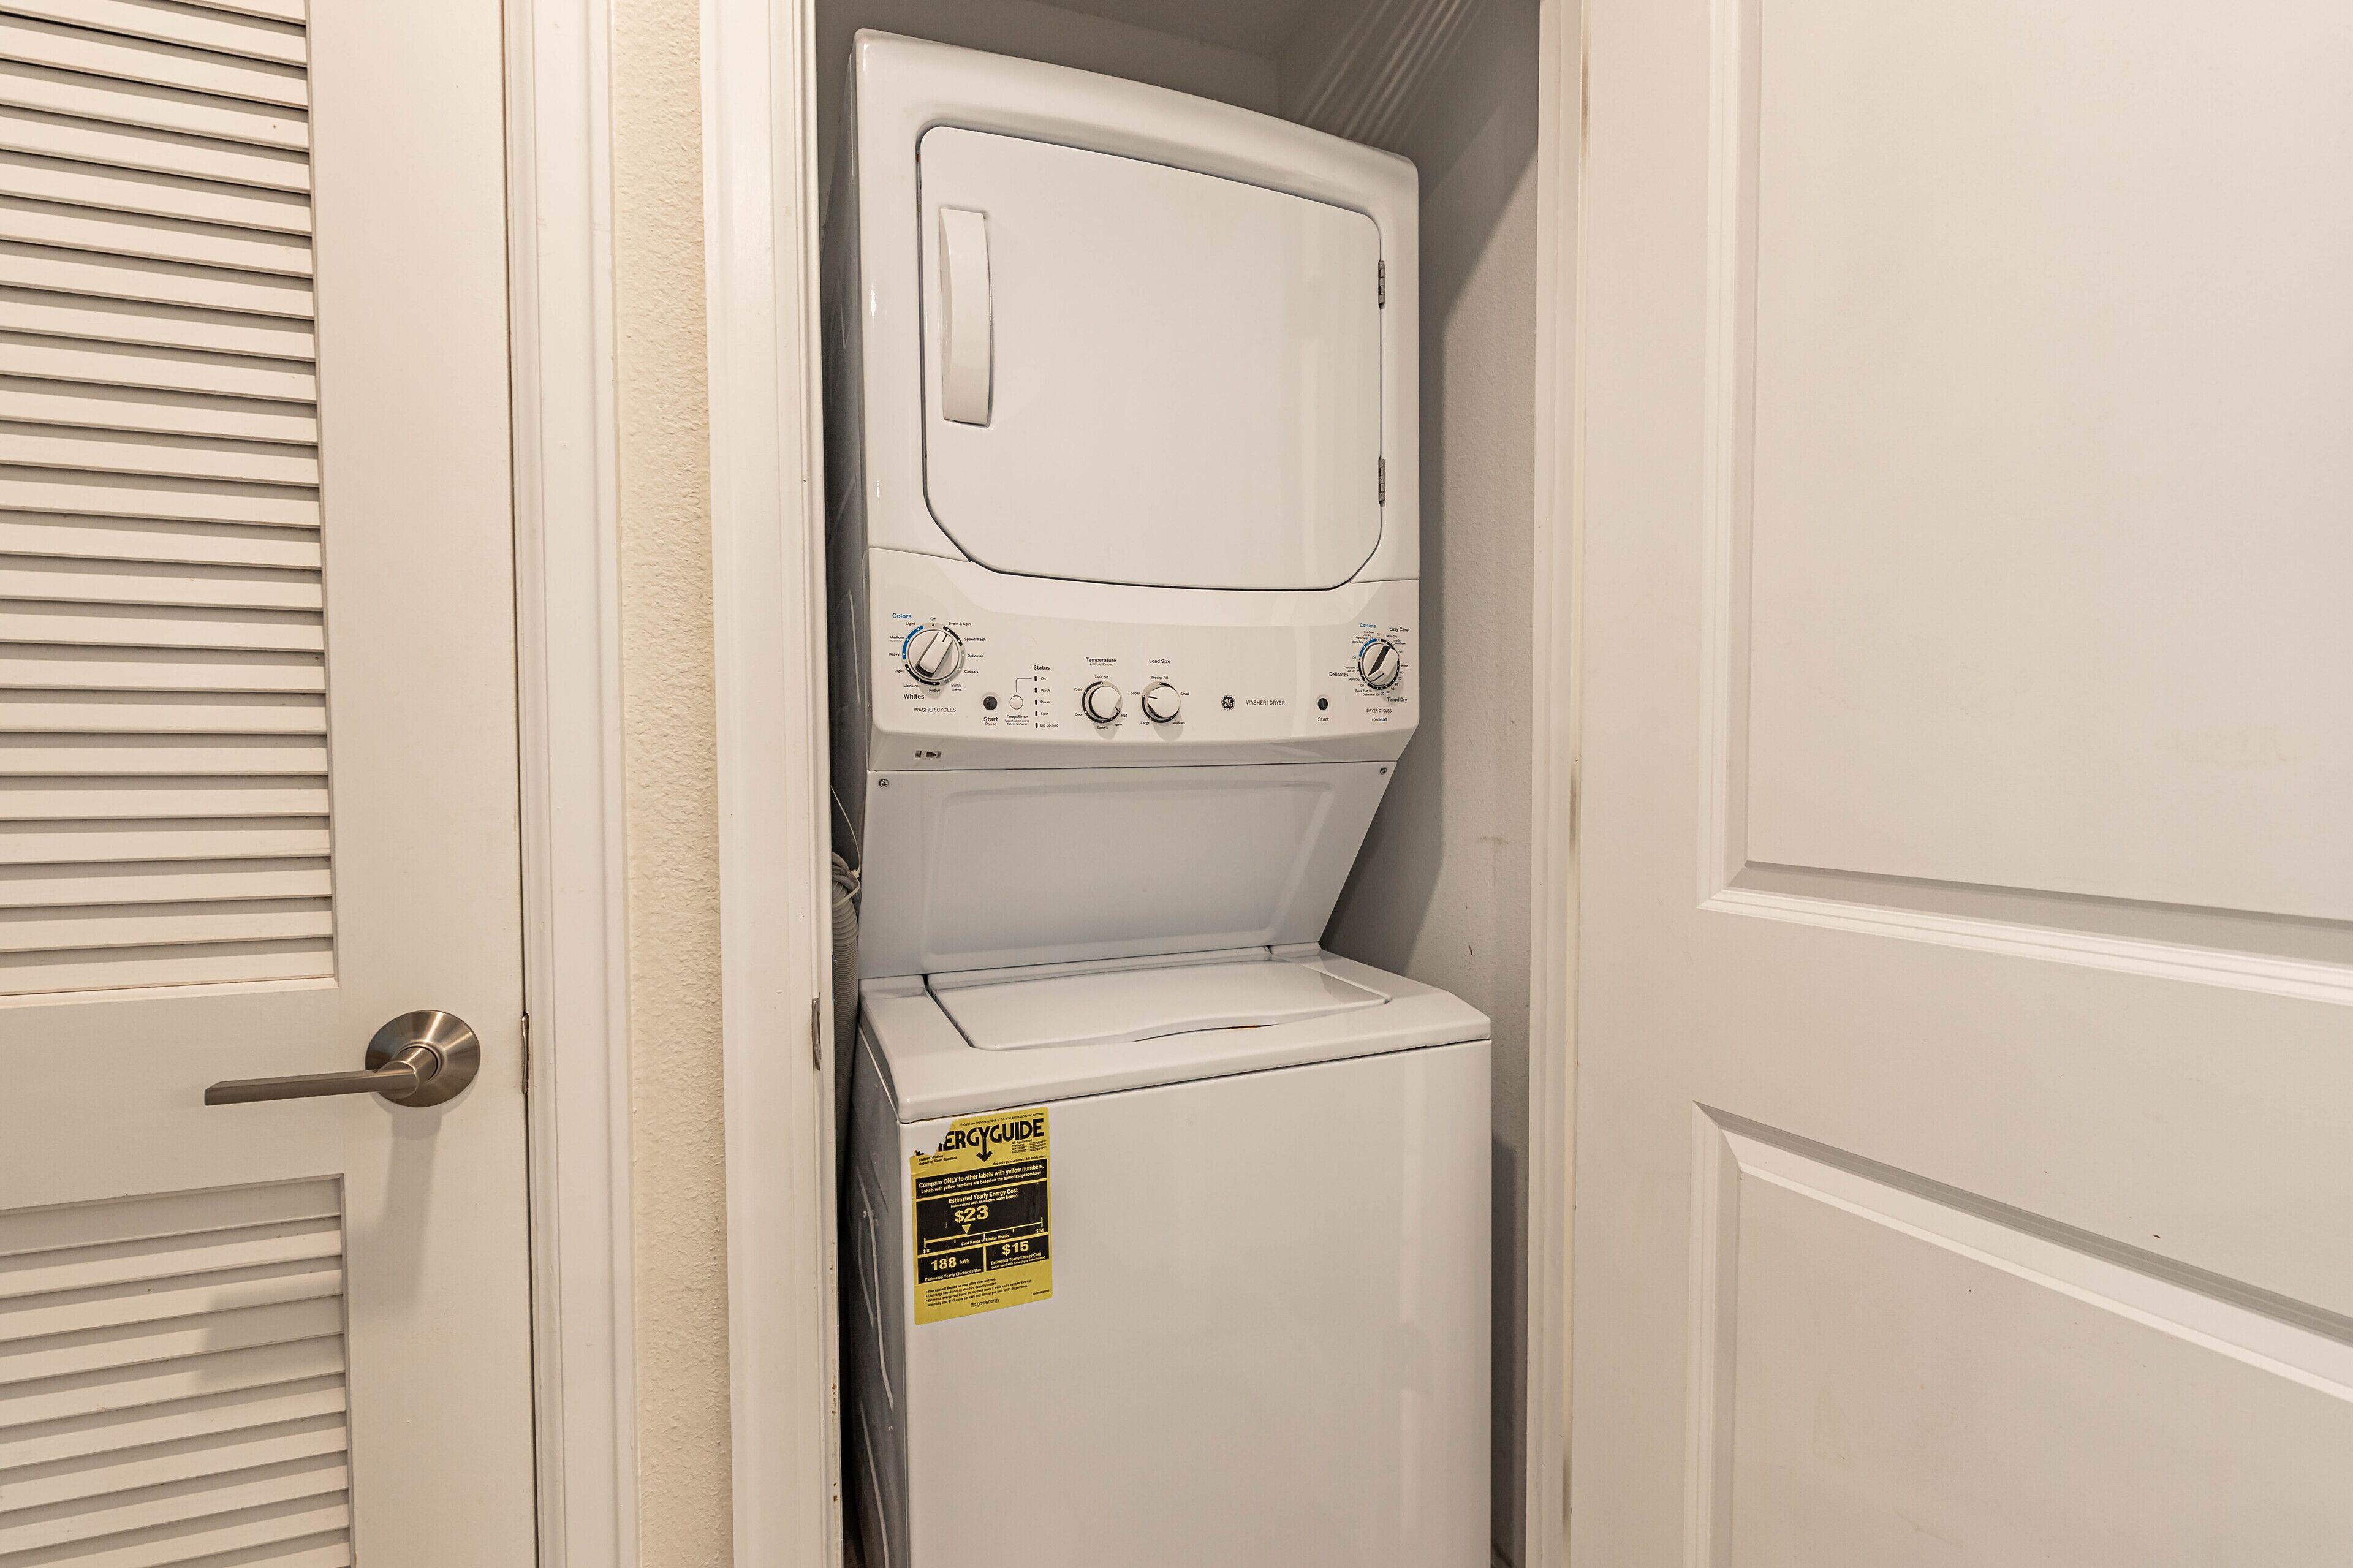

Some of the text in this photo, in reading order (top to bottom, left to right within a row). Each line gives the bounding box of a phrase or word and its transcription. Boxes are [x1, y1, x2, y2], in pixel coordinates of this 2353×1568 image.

[949, 1195, 972, 1204] Estimated
[954, 1205, 989, 1223] $23
[1002, 1241, 1029, 1256] $15
[931, 1257, 957, 1271] 188
